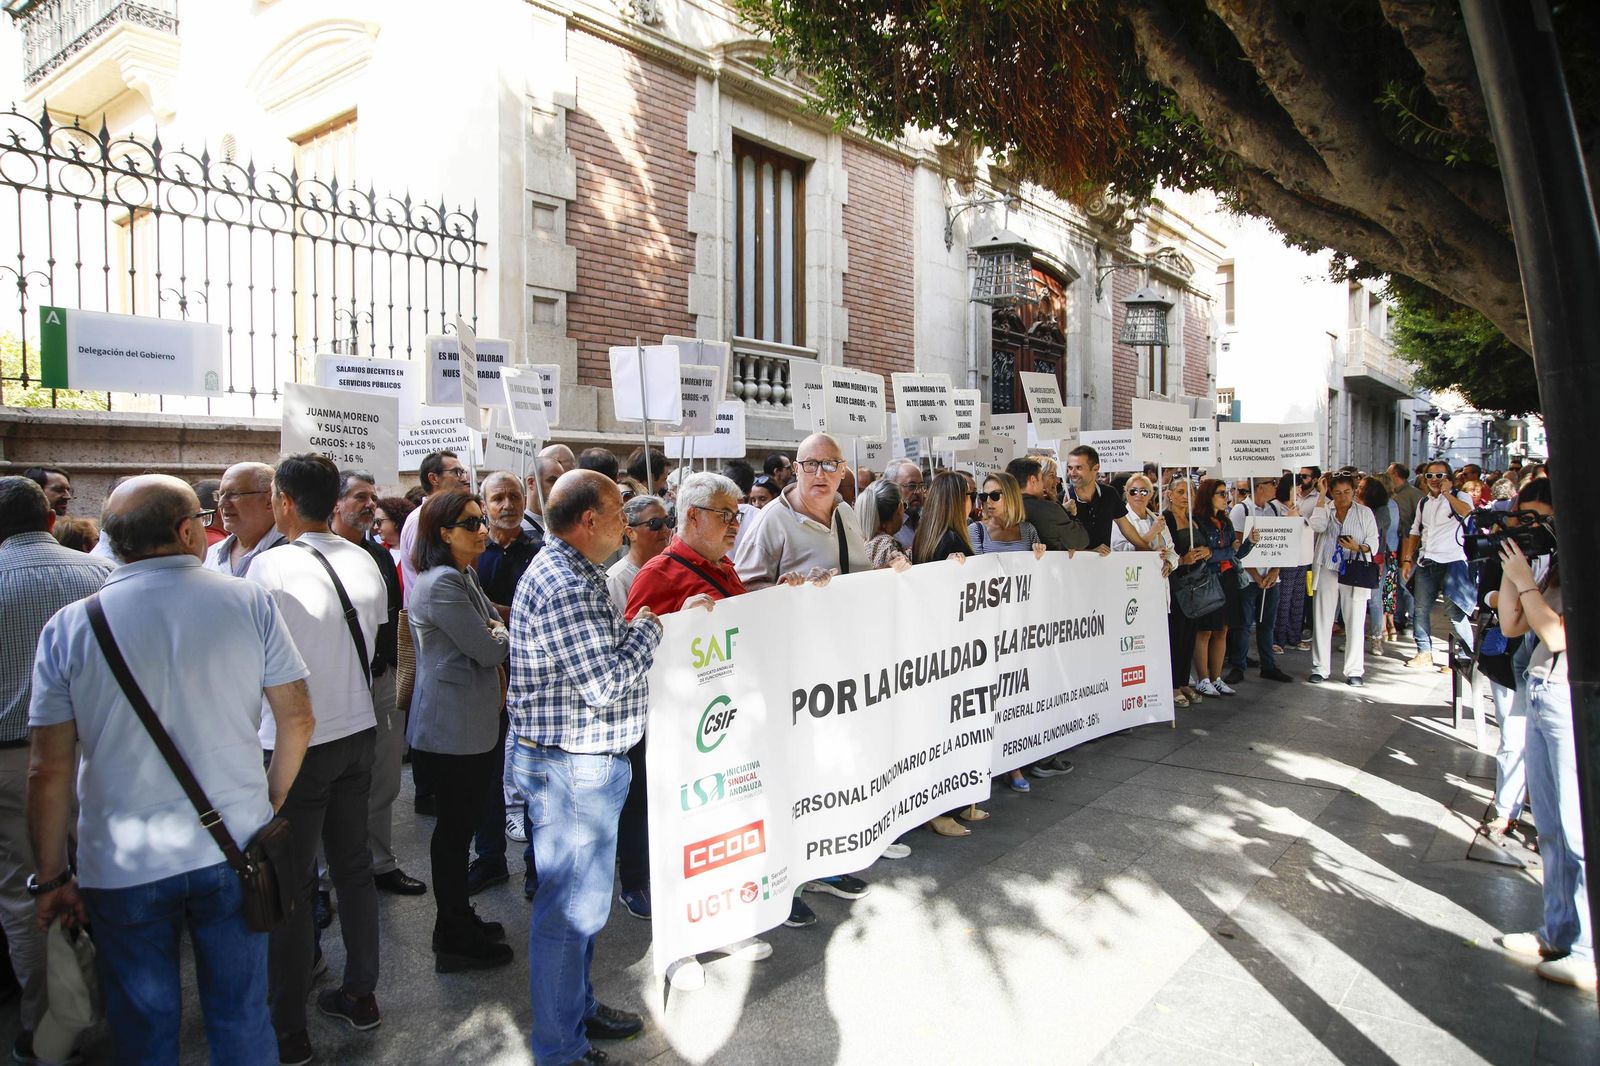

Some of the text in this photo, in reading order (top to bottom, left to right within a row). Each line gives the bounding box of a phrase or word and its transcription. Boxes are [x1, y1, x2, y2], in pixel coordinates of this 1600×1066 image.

[78, 346, 176, 361] Delegación del Gobierno
[438, 352, 447, 360] ES
[476, 354, 504, 363] VALORAR
[336, 365, 366, 374] SALARIOS
[366, 367, 396, 376] DECENTES
[442, 369, 500, 379] NUES RABAJO
[338, 379, 371, 388] SERVICIOS
[684, 378, 702, 387] MORENO
[705, 380, 713, 388] SUS
[832, 380, 850, 390] JUANMA
[850, 382, 867, 393] MORENO
[870, 386, 878, 394] SUS
[836, 396, 848, 405] ALTOS
[306, 407, 380, 423] JUANMA MORENO
[317, 422, 369, 436] Y SUS ALTOS
[420, 427, 457, 436] SERVICIOS
[1165, 425, 1183, 433] VALORAR
[309, 436, 348, 448] CARGOS:
[355, 441, 366, 449] 18
[367, 441, 376, 450] %
[501, 433, 513, 442] HORA
[1163, 433, 1182, 441] TRABAJO
[495, 442, 516, 452] NUESTRO
[343, 454, 354, 463] 16
[355, 454, 364, 463] %
[1015, 573, 1032, 603] YA!
[690, 627, 739, 669] SAF
[697, 663, 734, 677] SINDICATO ANDALUZ
[792, 609, 1105, 727] POR LA IGUALDAD LA RECUPERACIÓN
[1122, 669, 1144, 683] CCOO
[1121, 696, 1136, 711] UGT
[704, 708, 738, 736] CSIF
[870, 750, 927, 797] FUNCIONARIO
[928, 743, 941, 763] DE
[942, 738, 953, 756] LA
[1002, 702, 1035, 722] GENERAL
[1036, 699, 1045, 713] DE
[1045, 697, 1053, 710] LA
[1053, 691, 1070, 708] JUNTA
[1070, 689, 1078, 701] DE
[1078, 678, 1109, 700] ANDALUCÍA
[726, 760, 761, 777] INICIATIVA
[727, 771, 758, 787] SINDICAL
[729, 779, 763, 797] ANDALUZA
[806, 809, 891, 861] PRESIDENTE
[890, 806, 898, 822] Y
[898, 788, 929, 817] ALTOS
[931, 769, 984, 800] CARGOS:
[1002, 732, 1042, 757] PERSONAL
[1043, 718, 1085, 744] FUNCIONARIO:
[1085, 712, 1101, 728] -16%
[689, 829, 760, 870] CCOO
[687, 887, 735, 924] UGT
